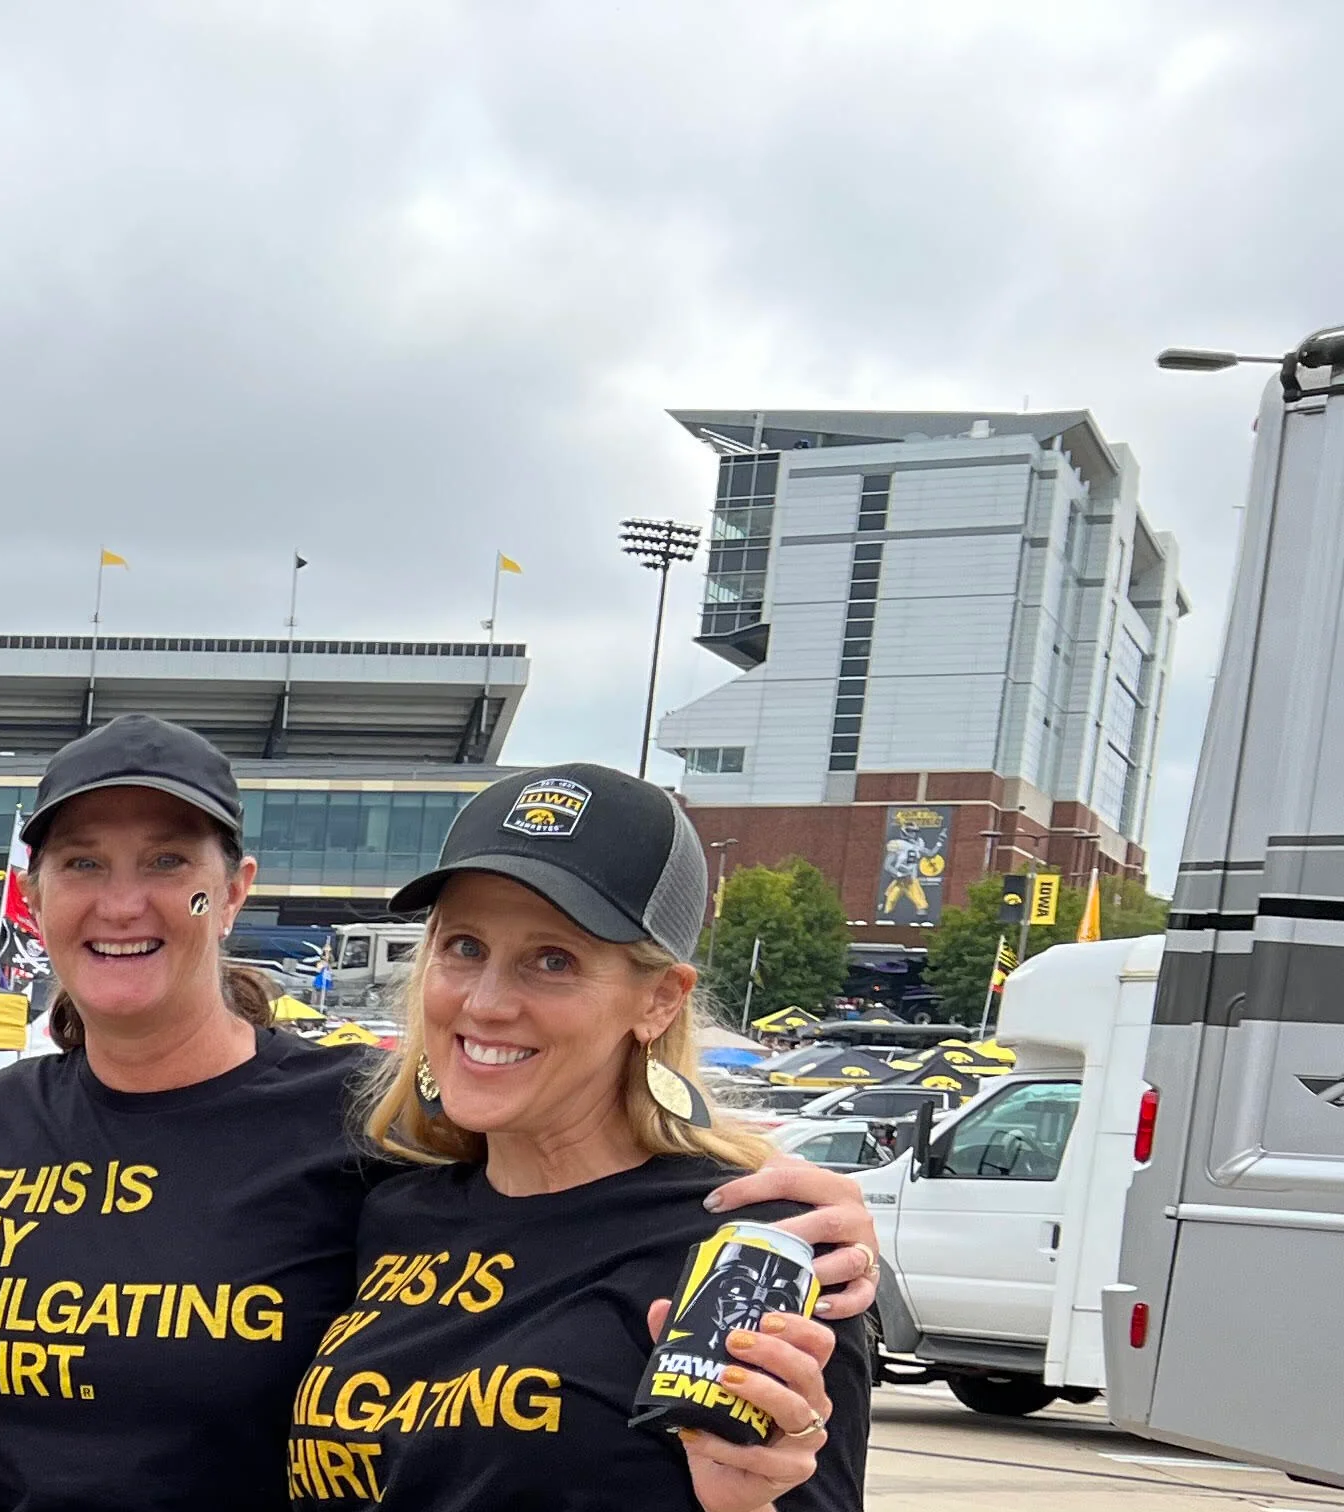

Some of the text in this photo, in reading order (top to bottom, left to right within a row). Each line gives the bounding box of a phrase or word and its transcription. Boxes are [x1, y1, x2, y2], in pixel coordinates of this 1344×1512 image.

[520, 793, 583, 811] IOWA
[1036, 881, 1053, 917] IOWA
[101, 1160, 158, 1214] IS
[356, 1251, 515, 1313] THIS IS
[658, 1354, 726, 1382] HAW
[294, 1365, 561, 1432] ILGATING
[287, 1439, 387, 1502] HIRT
